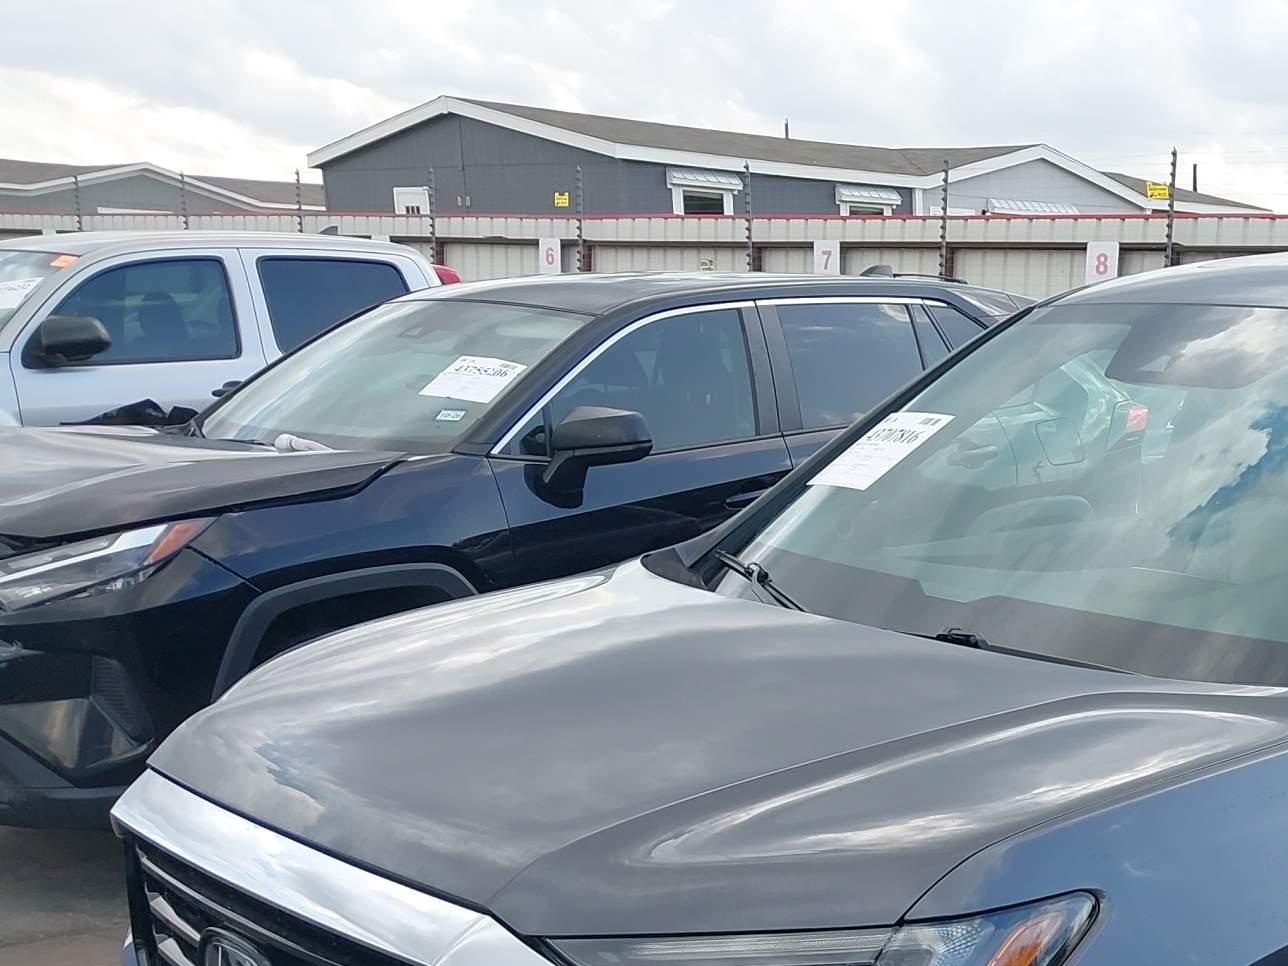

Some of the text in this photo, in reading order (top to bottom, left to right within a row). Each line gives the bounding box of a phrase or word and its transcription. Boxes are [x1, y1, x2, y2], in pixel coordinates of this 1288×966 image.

[545, 246, 555, 266] 6
[821, 249, 832, 270] 7
[1095, 252, 1109, 275] 8
